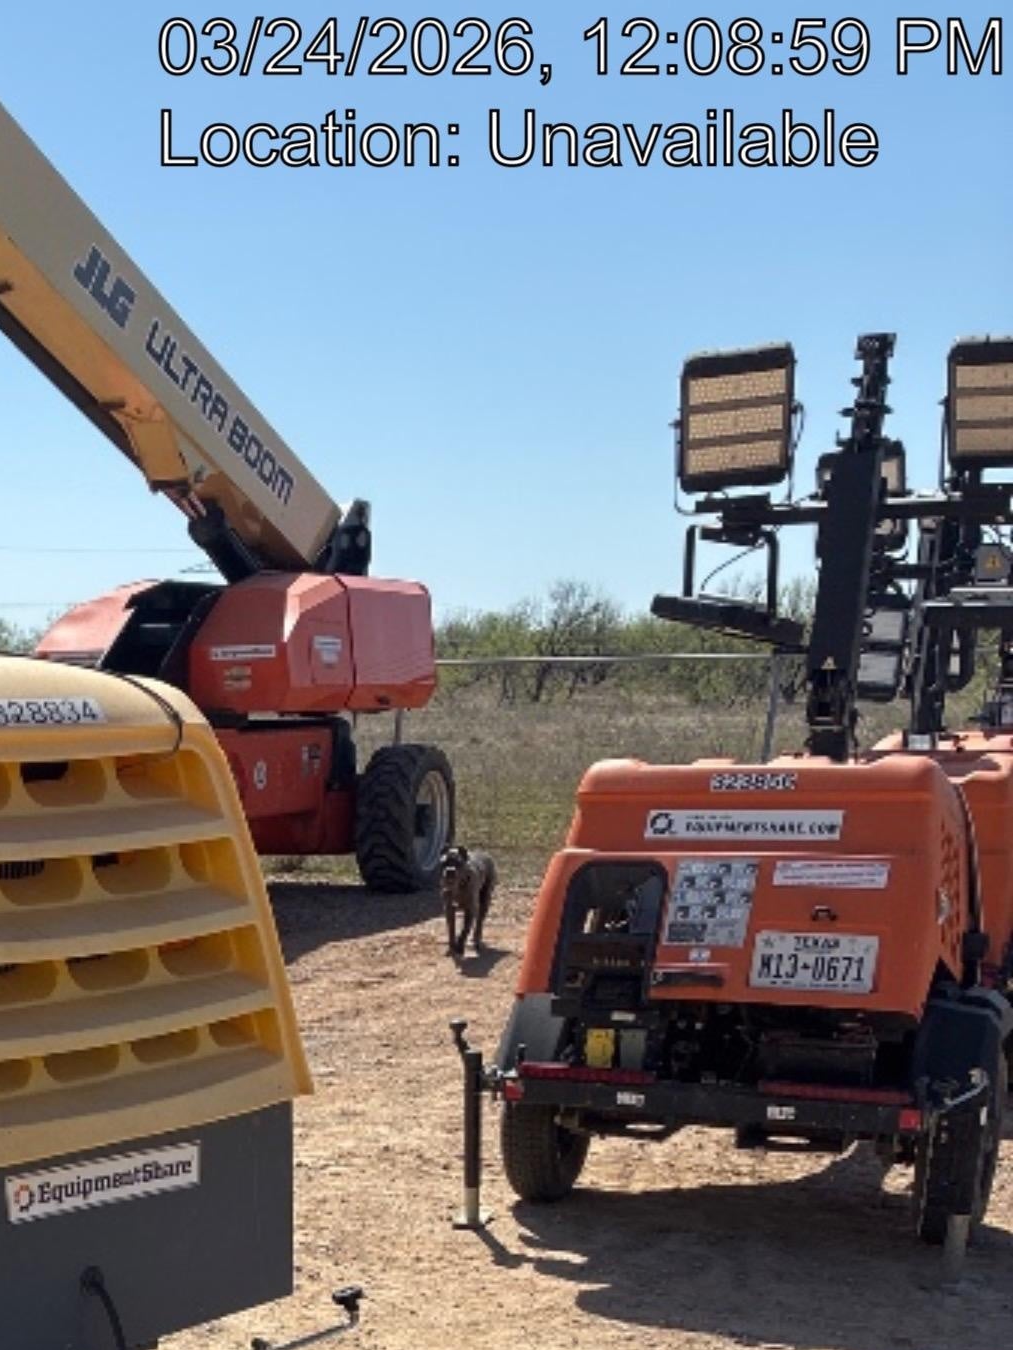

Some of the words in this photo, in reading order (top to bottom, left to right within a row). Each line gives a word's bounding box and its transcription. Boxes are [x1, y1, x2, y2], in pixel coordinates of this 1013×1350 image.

[74, 244, 136, 328] JLG
[145, 320, 230, 433] ULTRA
[226, 416, 295, 505] BOOM
[38, 1159, 193, 1204] EquipmentShare
